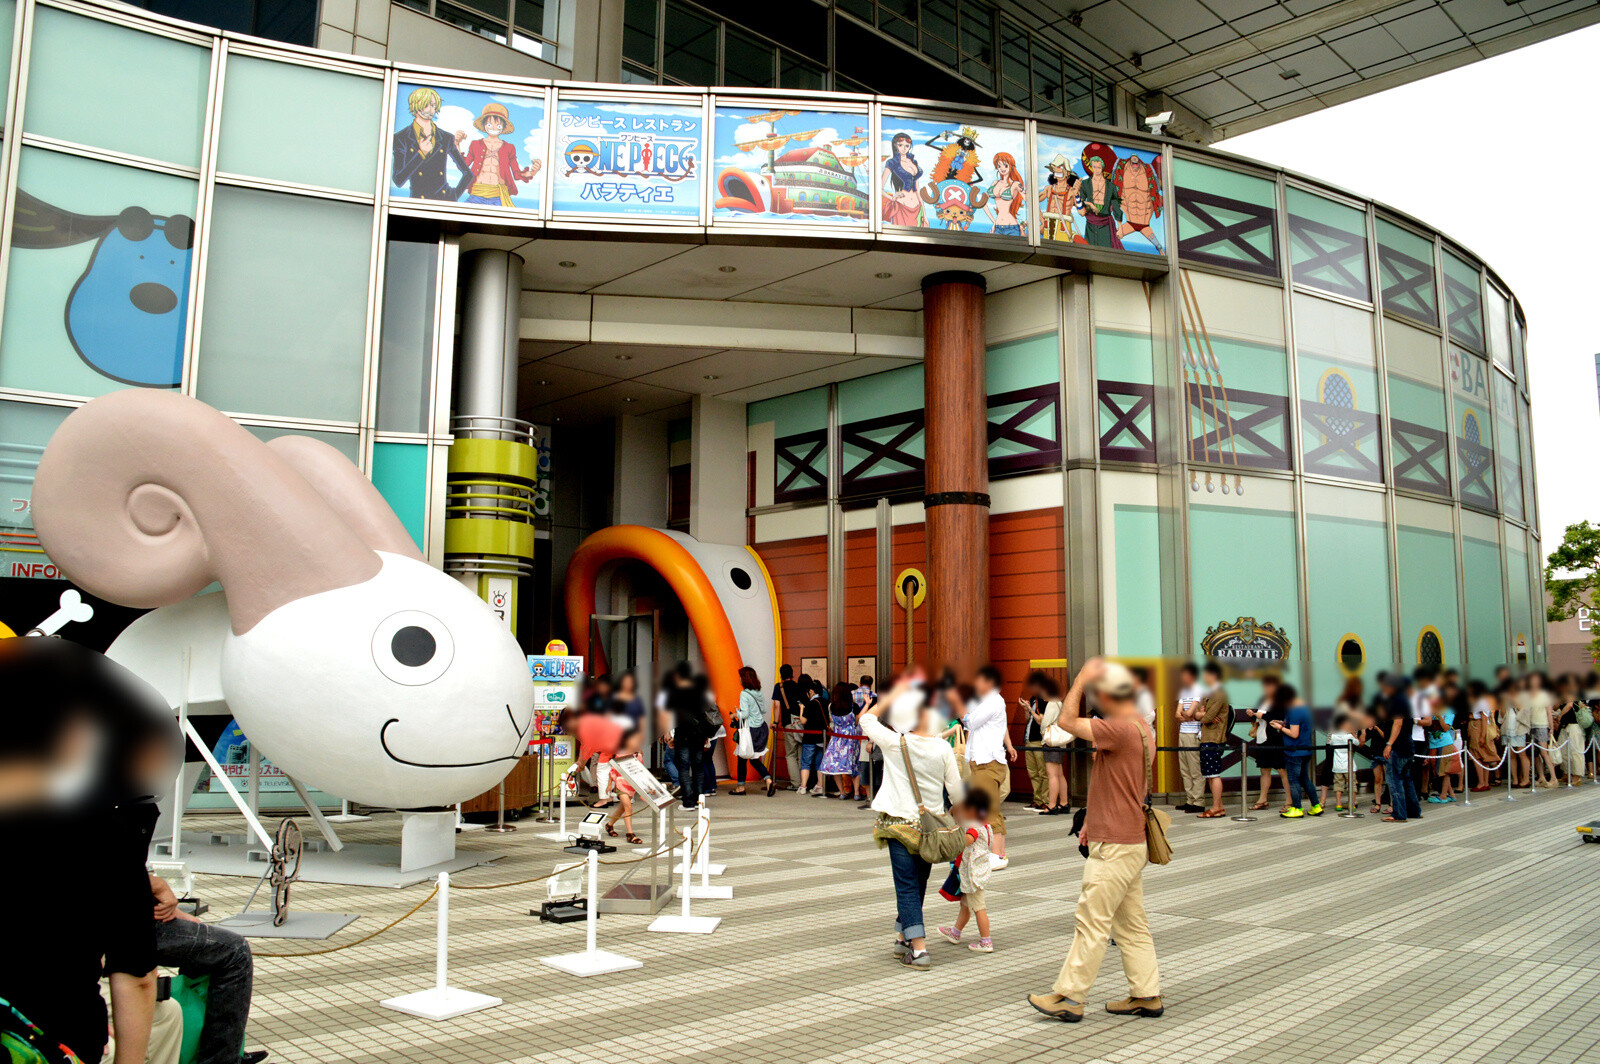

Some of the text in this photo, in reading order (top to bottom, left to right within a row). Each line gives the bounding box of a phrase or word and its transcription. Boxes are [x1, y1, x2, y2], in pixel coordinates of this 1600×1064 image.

[560, 114, 697, 132] ワンピース レストラン
[628, 141, 696, 176] PIECE
[580, 182, 674, 203] バラティエ
